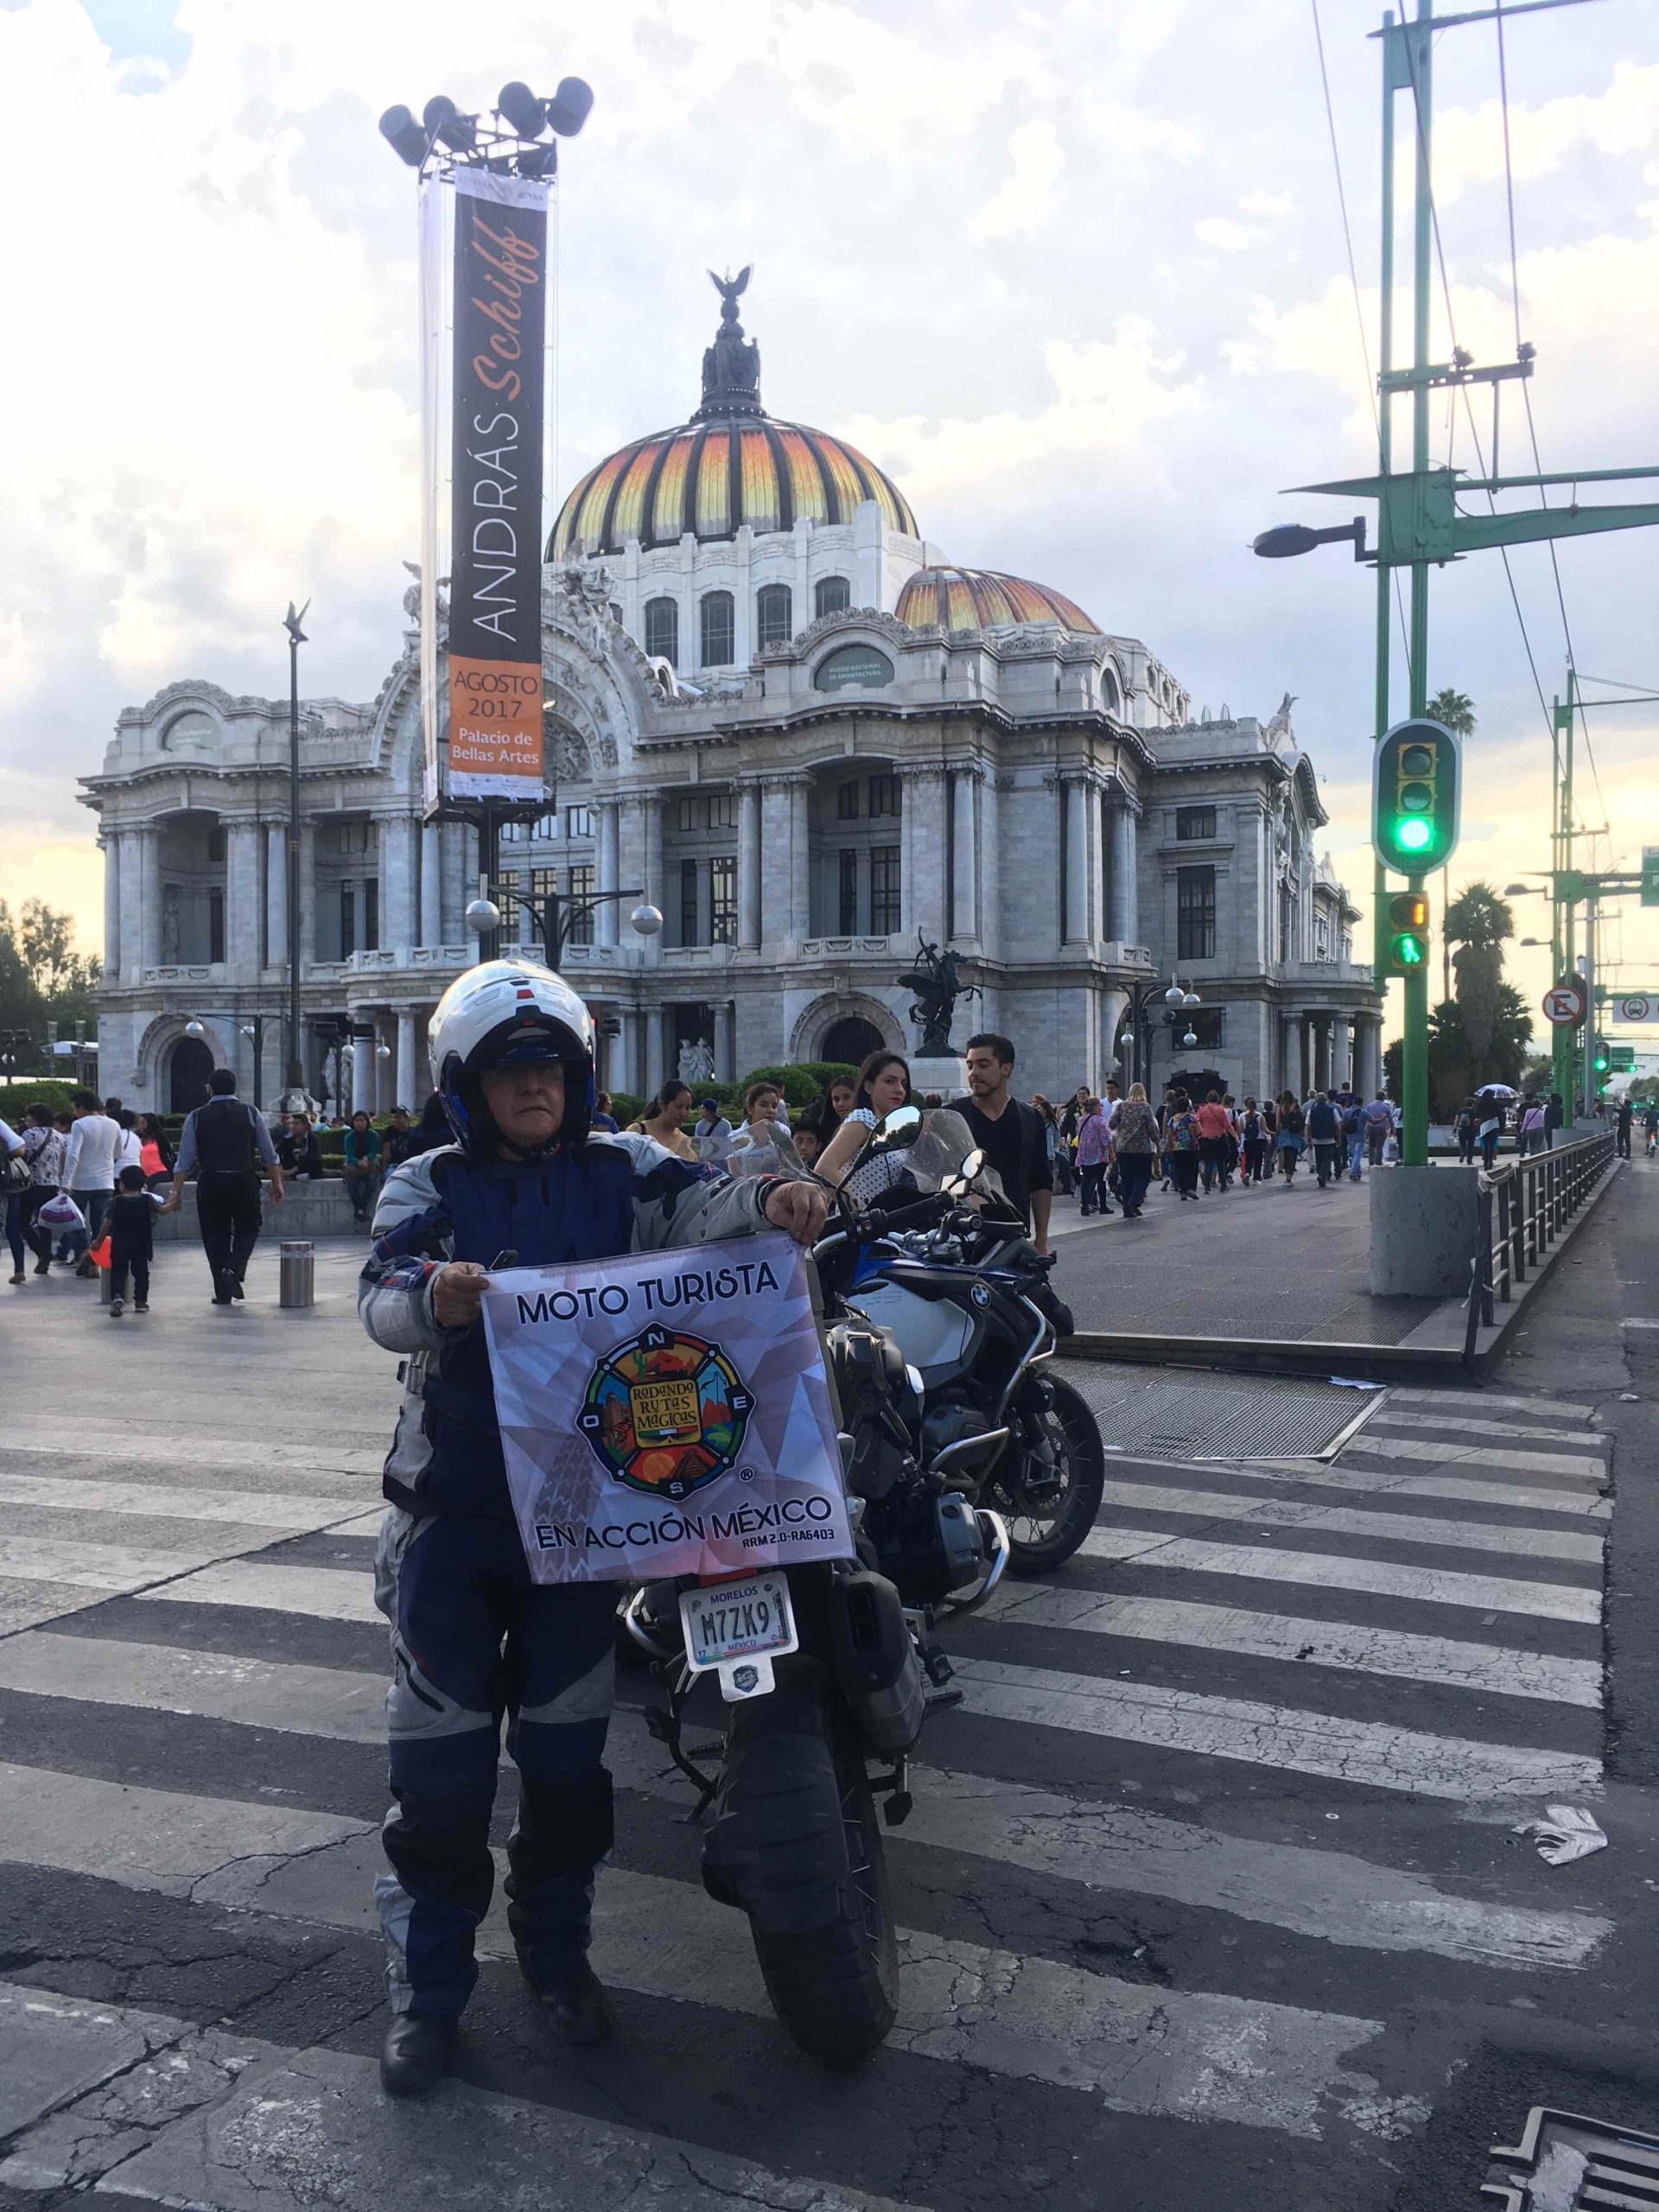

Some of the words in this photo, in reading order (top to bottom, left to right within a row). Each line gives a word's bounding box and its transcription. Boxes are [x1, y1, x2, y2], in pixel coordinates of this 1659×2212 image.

[470, 216, 539, 401] Schiff
[467, 413, 518, 642] ANDRÁS
[454, 670, 538, 695] AGOSTO
[468, 698, 523, 719] 2017
[459, 728, 511, 744] Palacio
[514, 732, 532, 746] de
[452, 746, 495, 762] Bellas
[499, 749, 539, 765] Artes
[517, 1285, 629, 1324] MOTO
[637, 1262, 779, 1310] TURISTA
[648, 1332, 665, 1345] N
[733, 1395, 747, 1409] E
[582, 1414, 600, 1428] O
[670, 1482, 683, 1494] S
[535, 1524, 577, 1549] EN
[584, 1511, 706, 1548] ACCIÓN
[711, 1496, 832, 1539] MÉXICO
[742, 1535, 768, 1548] RRM
[709, 1586, 759, 1605] MORELOS
[701, 1601, 770, 1646] M7ZK9
[728, 1639, 757, 1651] MÉXICO
